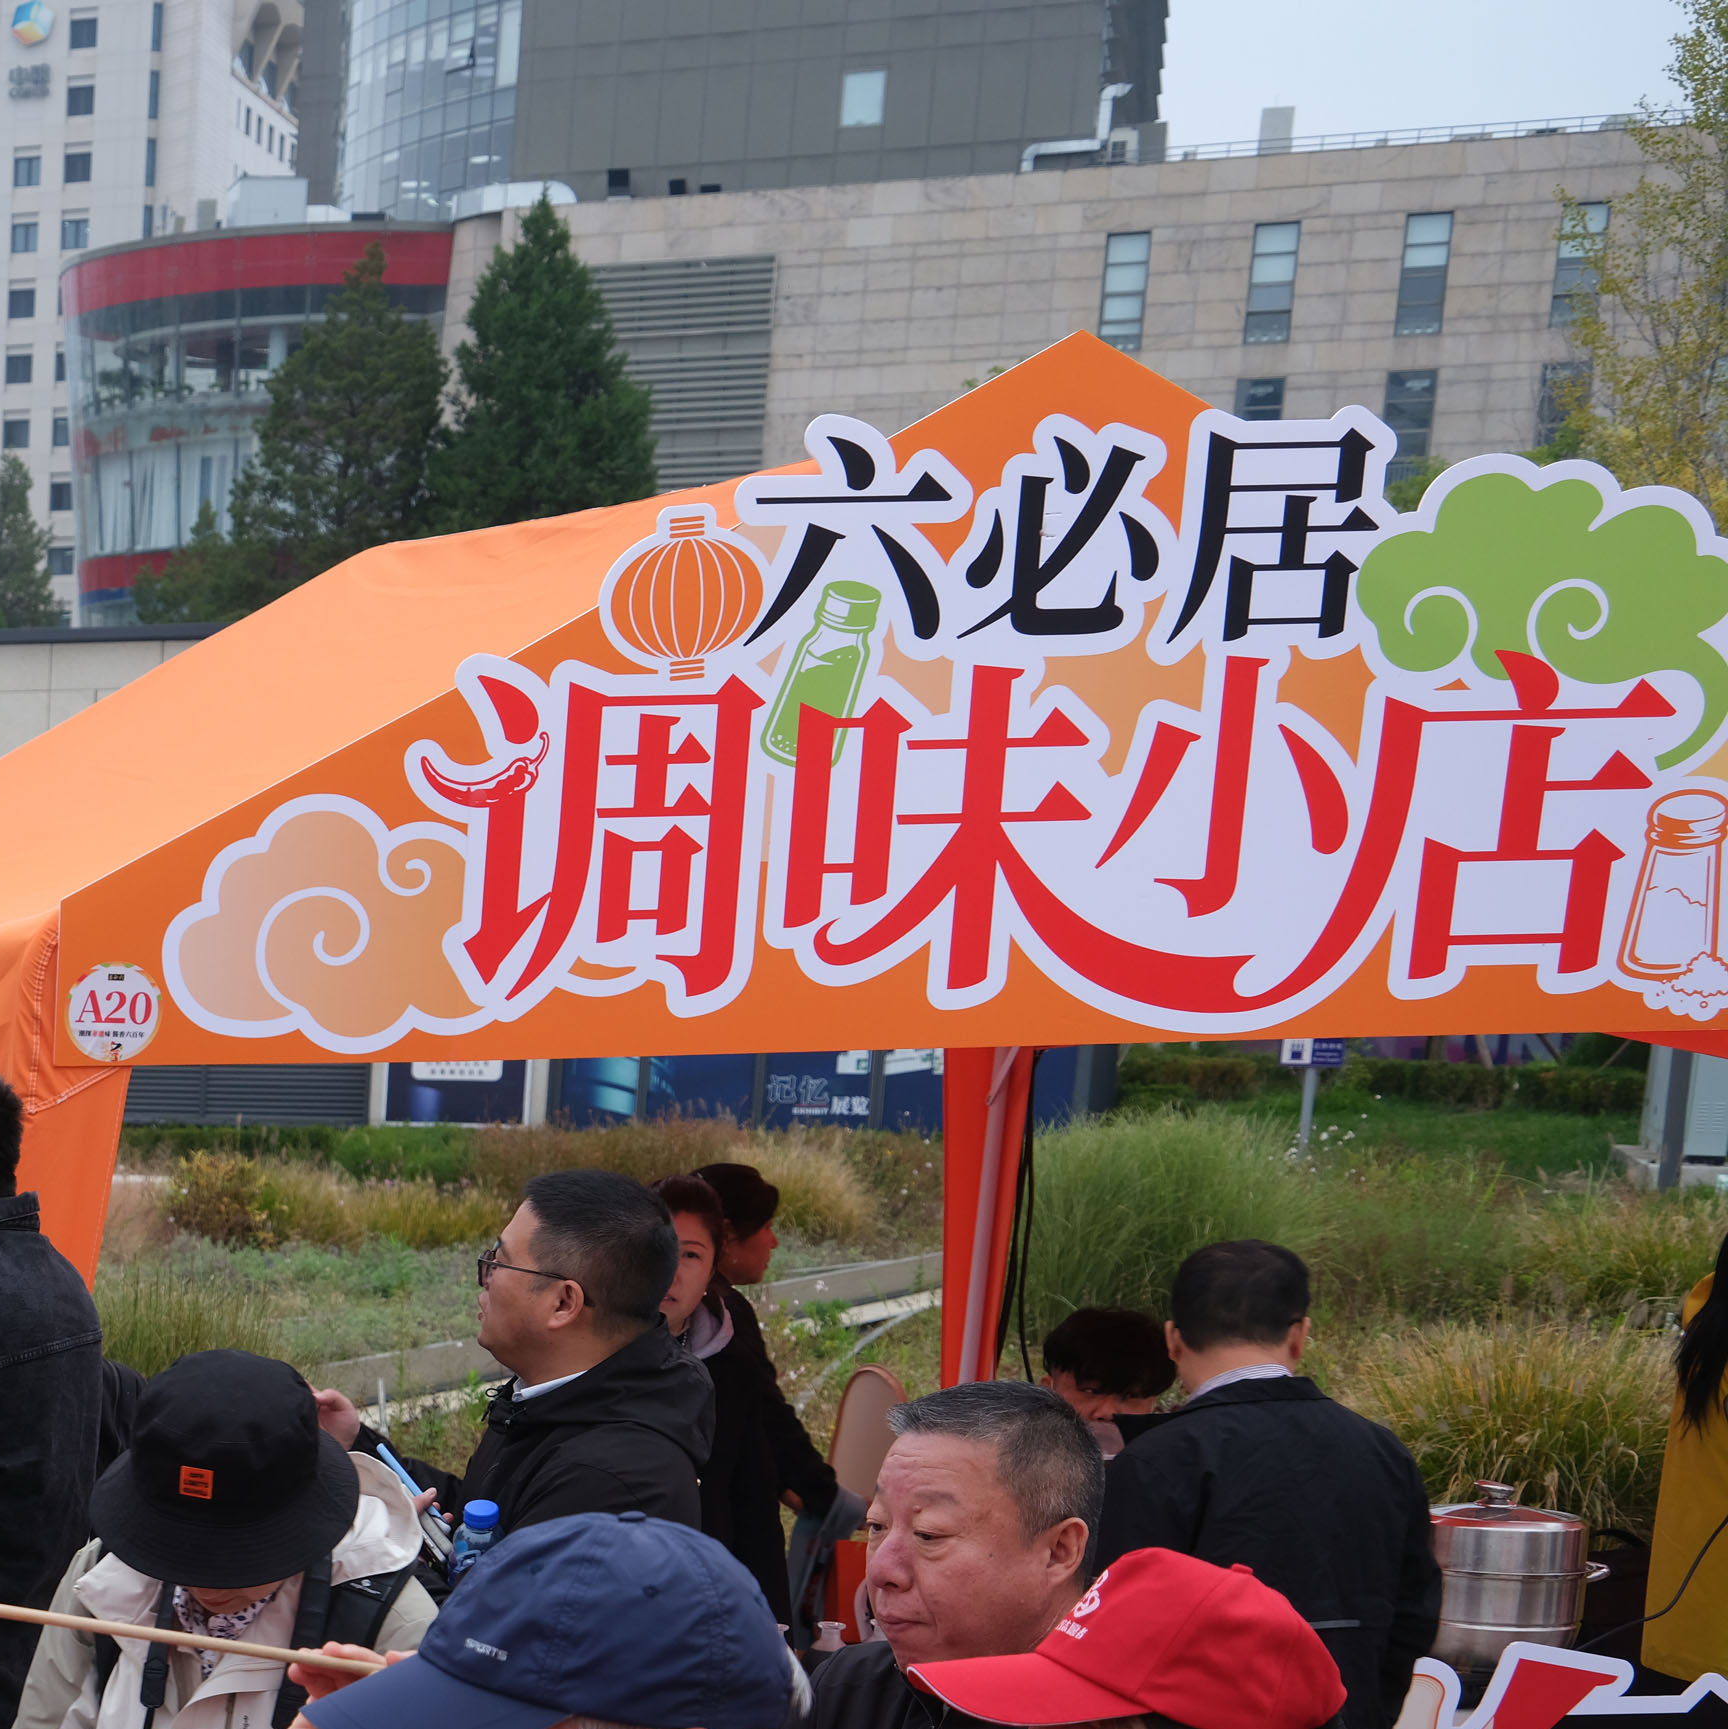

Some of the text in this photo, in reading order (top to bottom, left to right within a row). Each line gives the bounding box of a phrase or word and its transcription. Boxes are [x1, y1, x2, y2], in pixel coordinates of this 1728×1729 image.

[744, 428, 1380, 647] 六必居
[421, 650, 1676, 1013] 调味小店
[75, 990, 152, 1026] A20
[768, 1074, 830, 1105] 记忆
